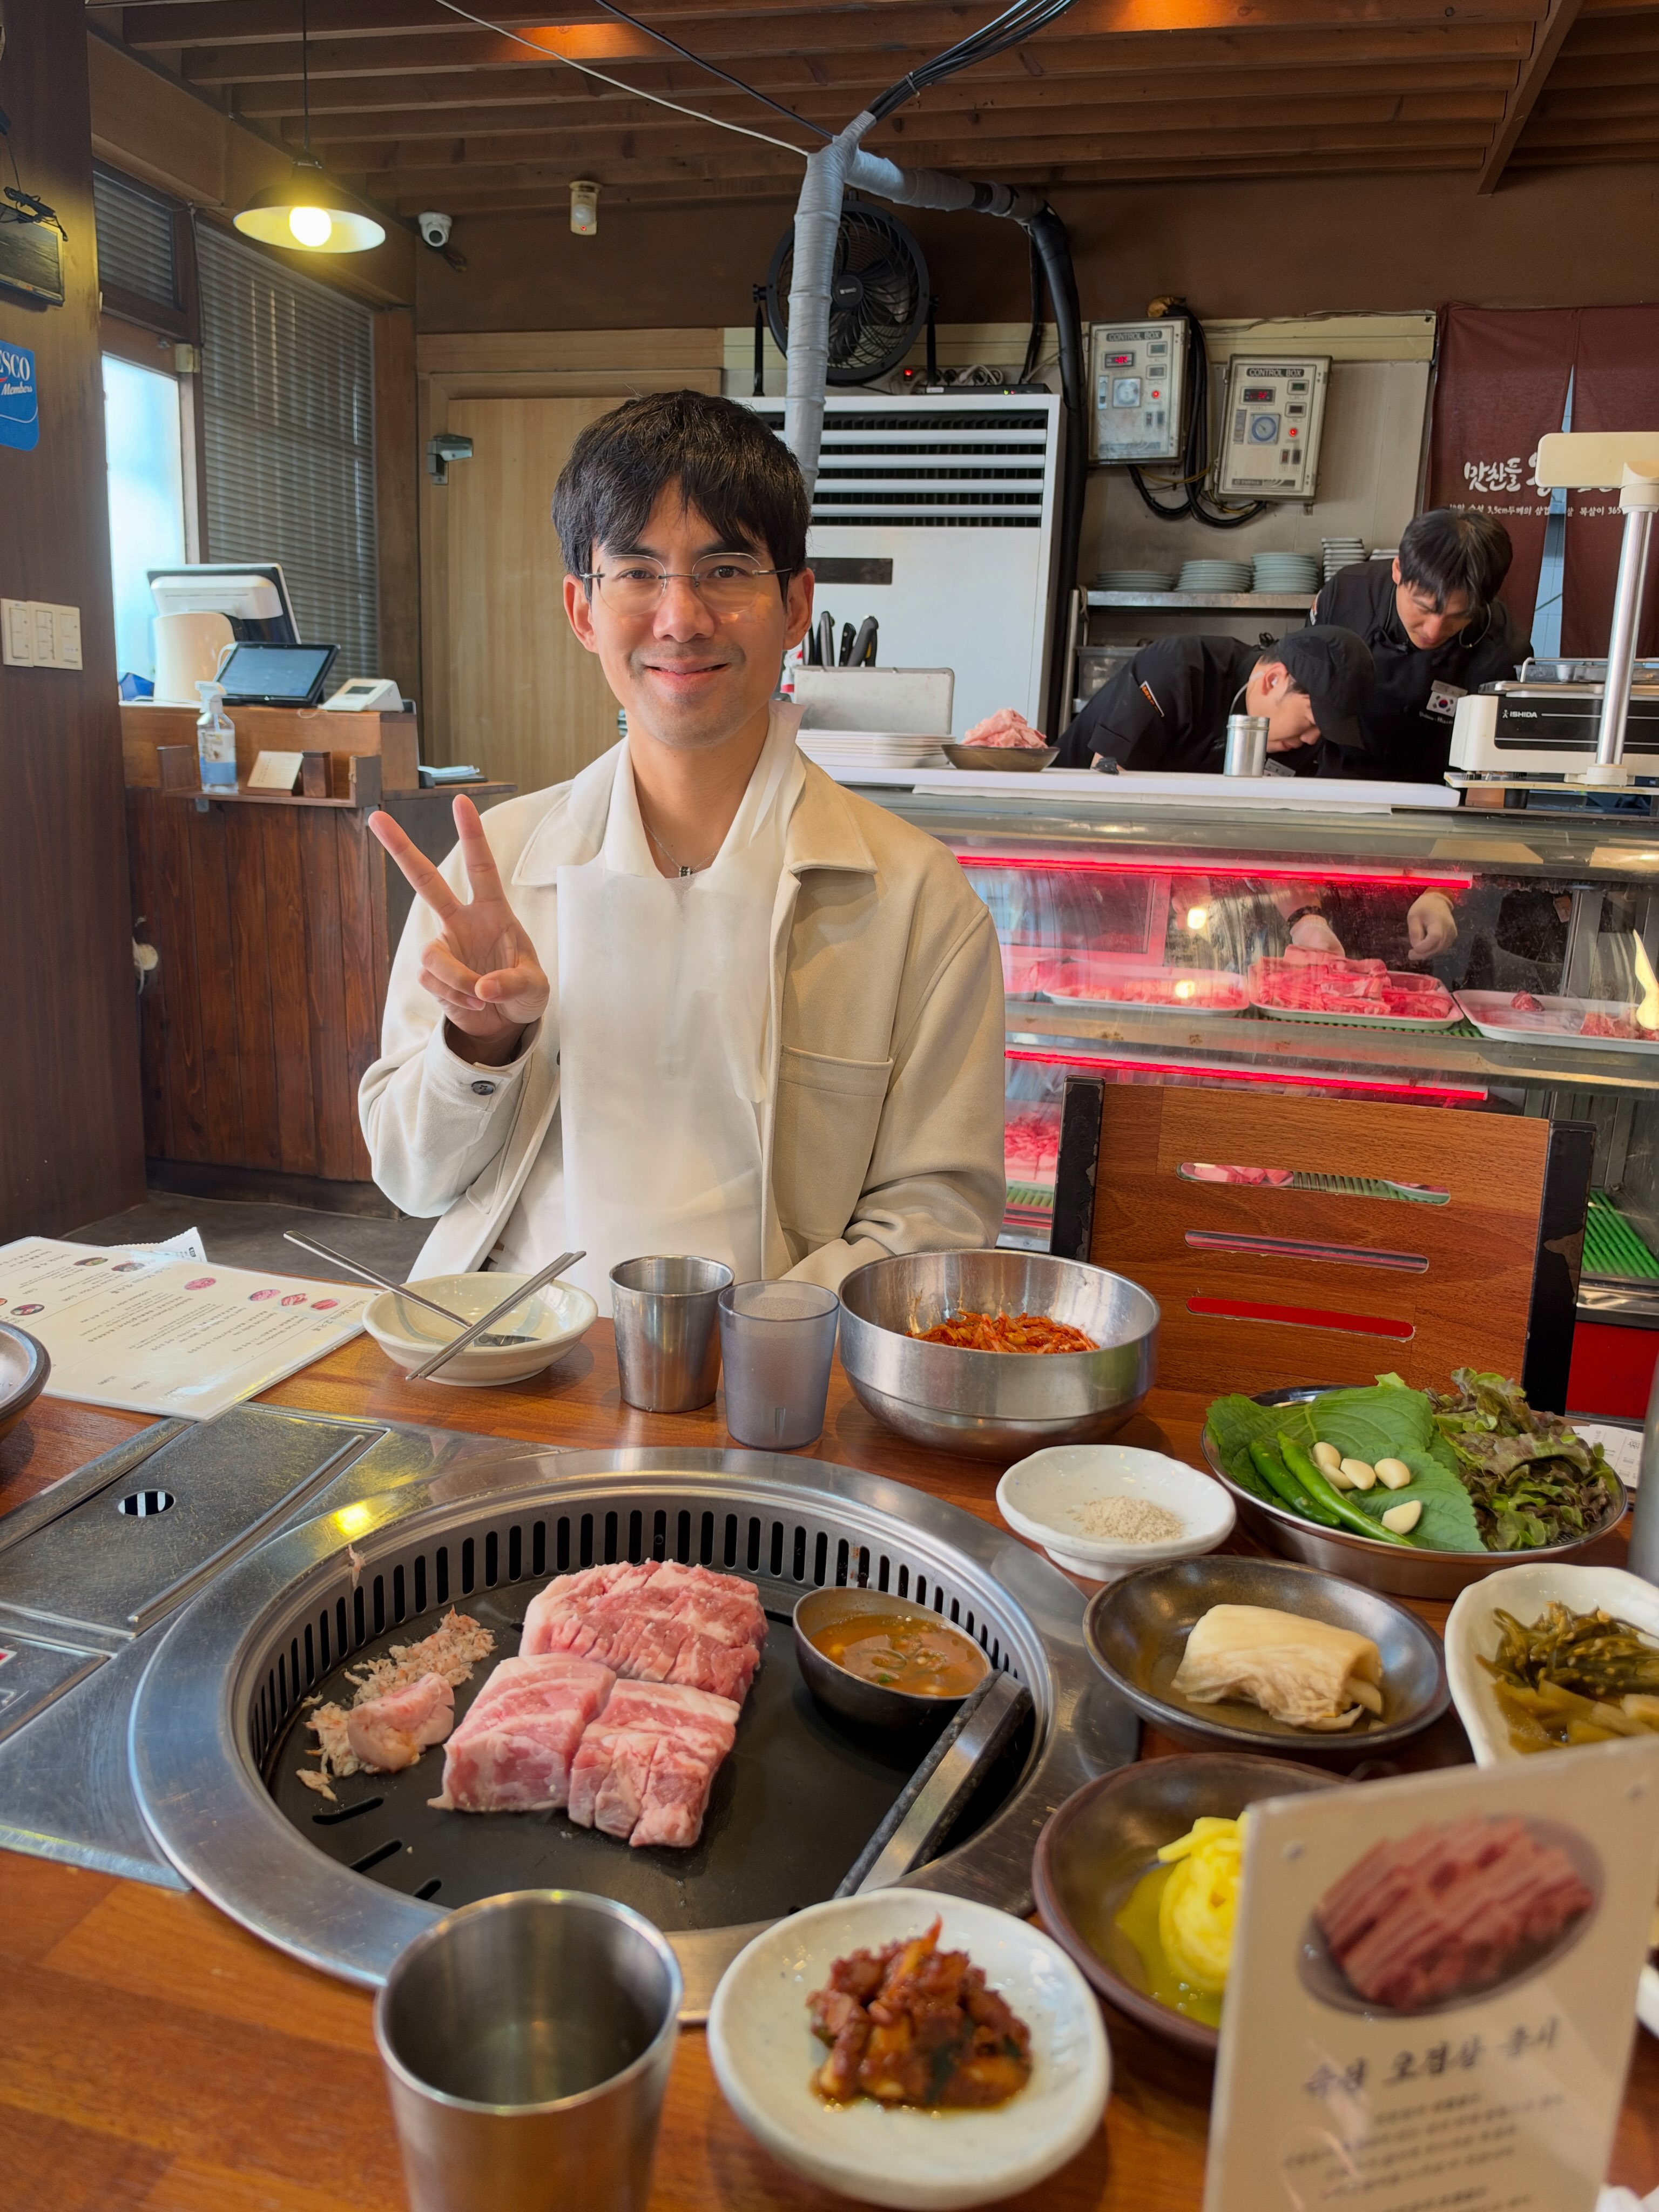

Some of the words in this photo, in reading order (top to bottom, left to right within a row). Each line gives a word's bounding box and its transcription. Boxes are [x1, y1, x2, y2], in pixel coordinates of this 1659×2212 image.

[1109, 332, 1141, 341] CONTROL
[1144, 331, 1160, 340] BOX
[1249, 369, 1283, 377] CONTROL
[1, 381, 32, 395] Members
[1464, 457, 1522, 493] 맛찬들
